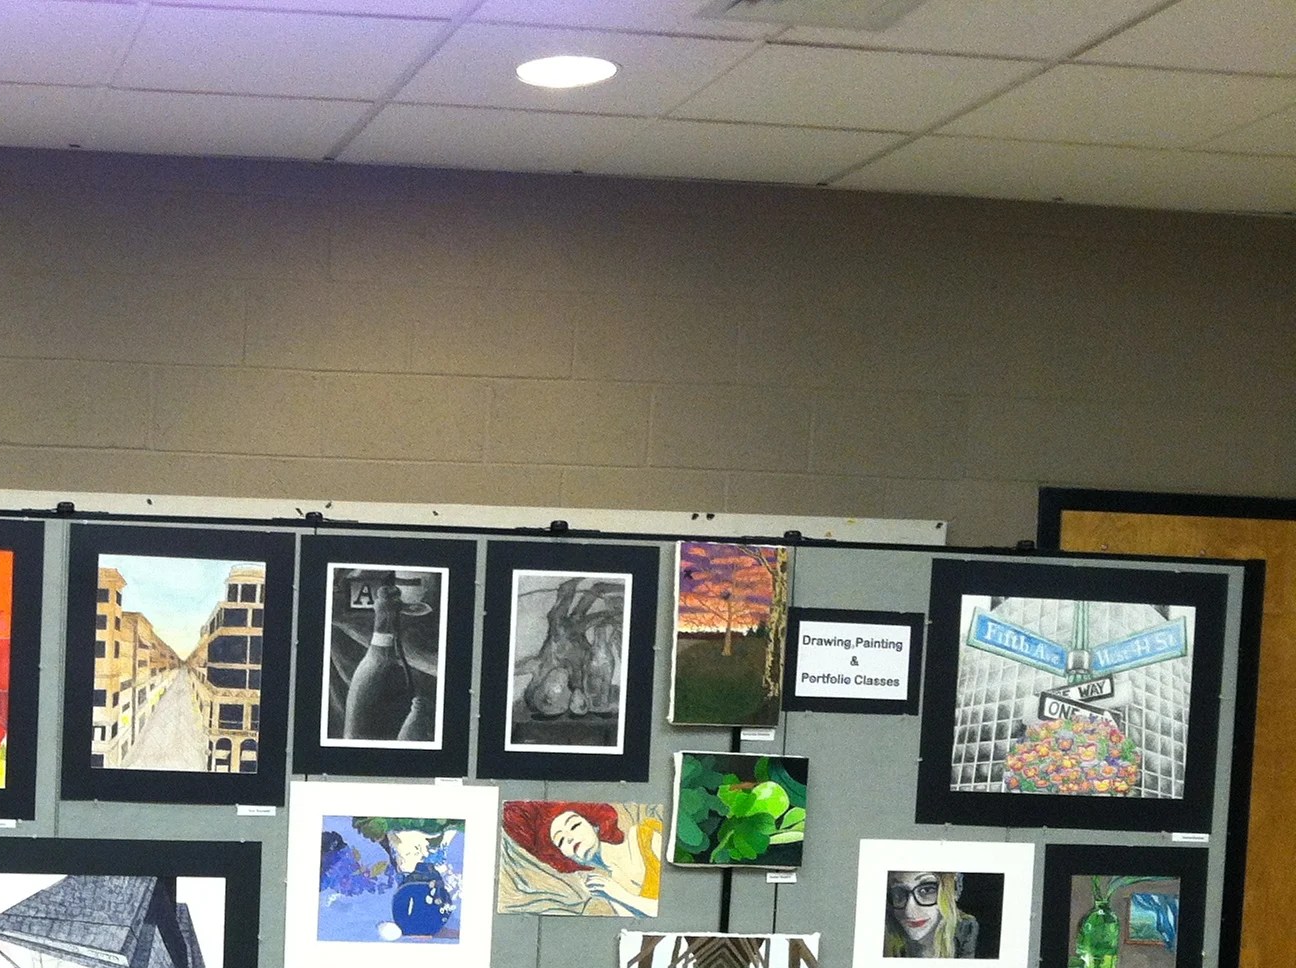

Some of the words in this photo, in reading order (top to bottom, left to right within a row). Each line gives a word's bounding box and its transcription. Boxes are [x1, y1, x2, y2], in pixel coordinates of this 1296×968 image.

[353, 584, 374, 605] A
[984, 622, 1031, 654] Fifth
[849, 655, 859, 667] &
[801, 672, 851, 685] Portfolio
[854, 674, 900, 687] Classes
[1078, 679, 1106, 698] WAY
